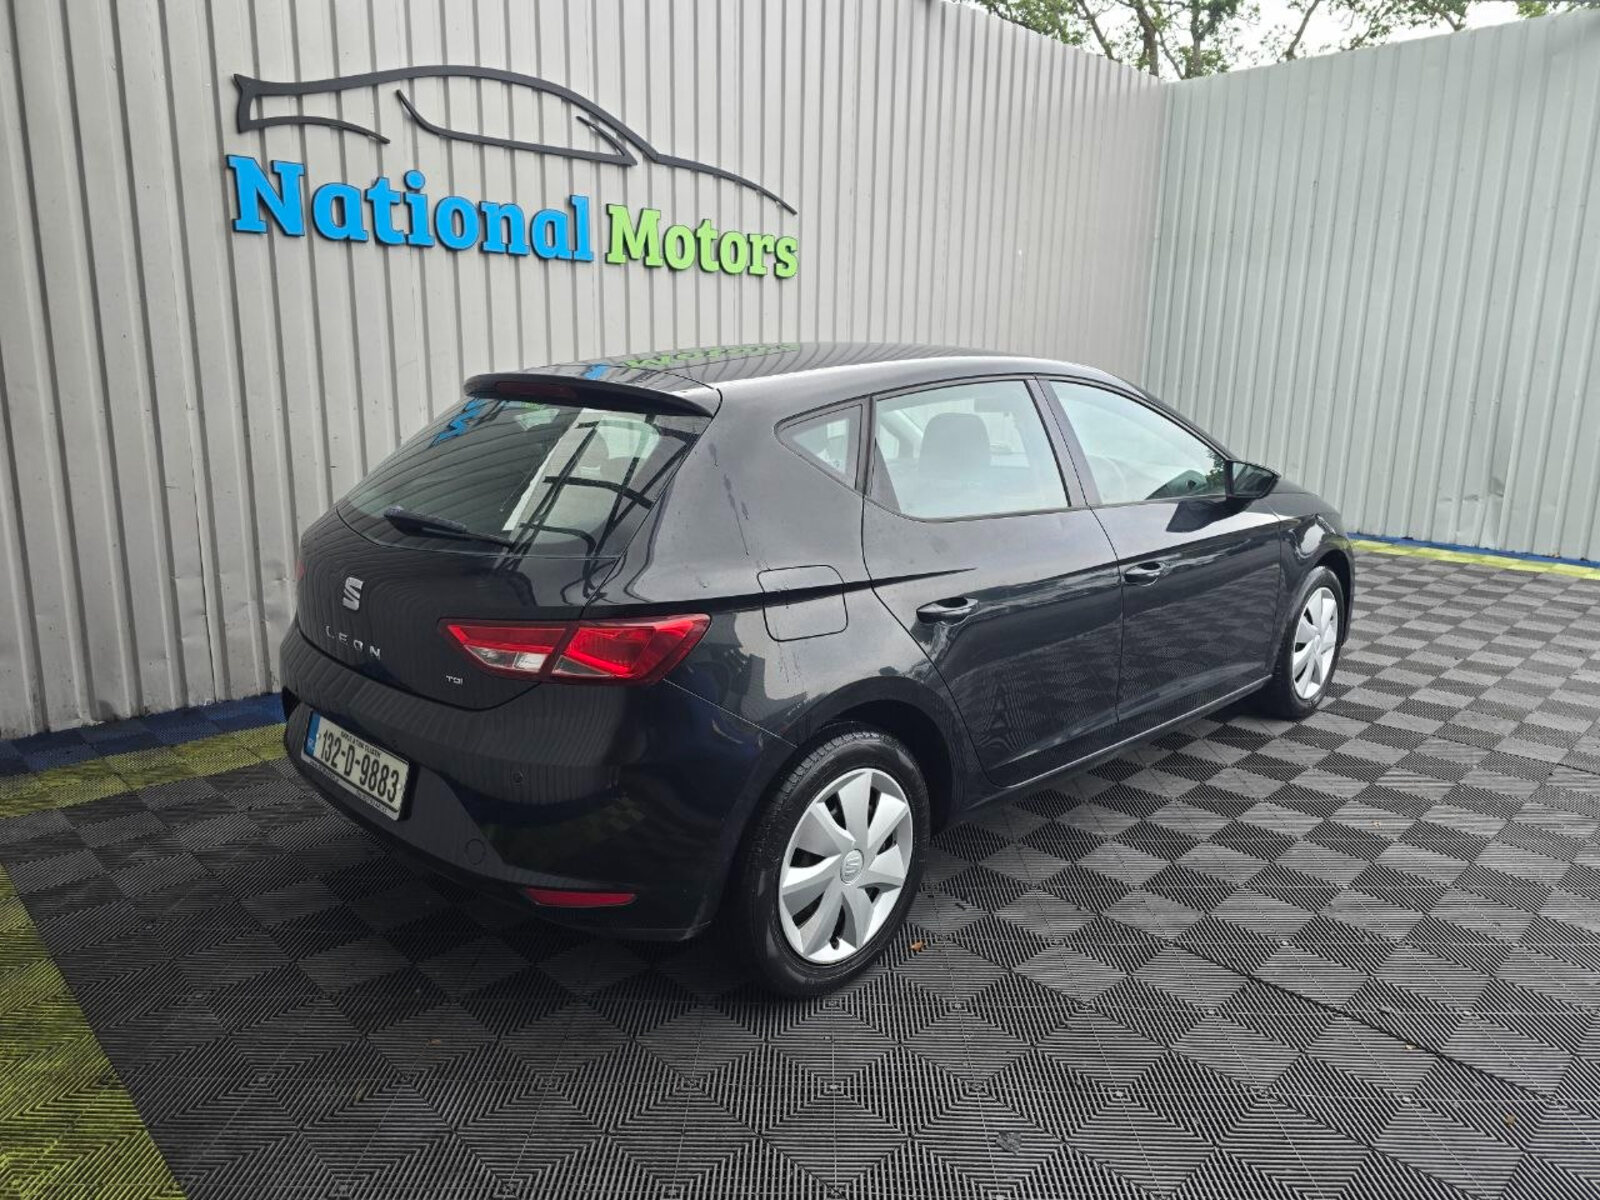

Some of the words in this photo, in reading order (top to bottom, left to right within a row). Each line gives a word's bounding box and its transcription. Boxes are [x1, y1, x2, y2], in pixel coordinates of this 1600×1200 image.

[227, 154, 594, 262] National
[605, 203, 799, 279] Motors
[325, 625, 381, 660] LEON
[320, 729, 400, 803] 132-D-9883
